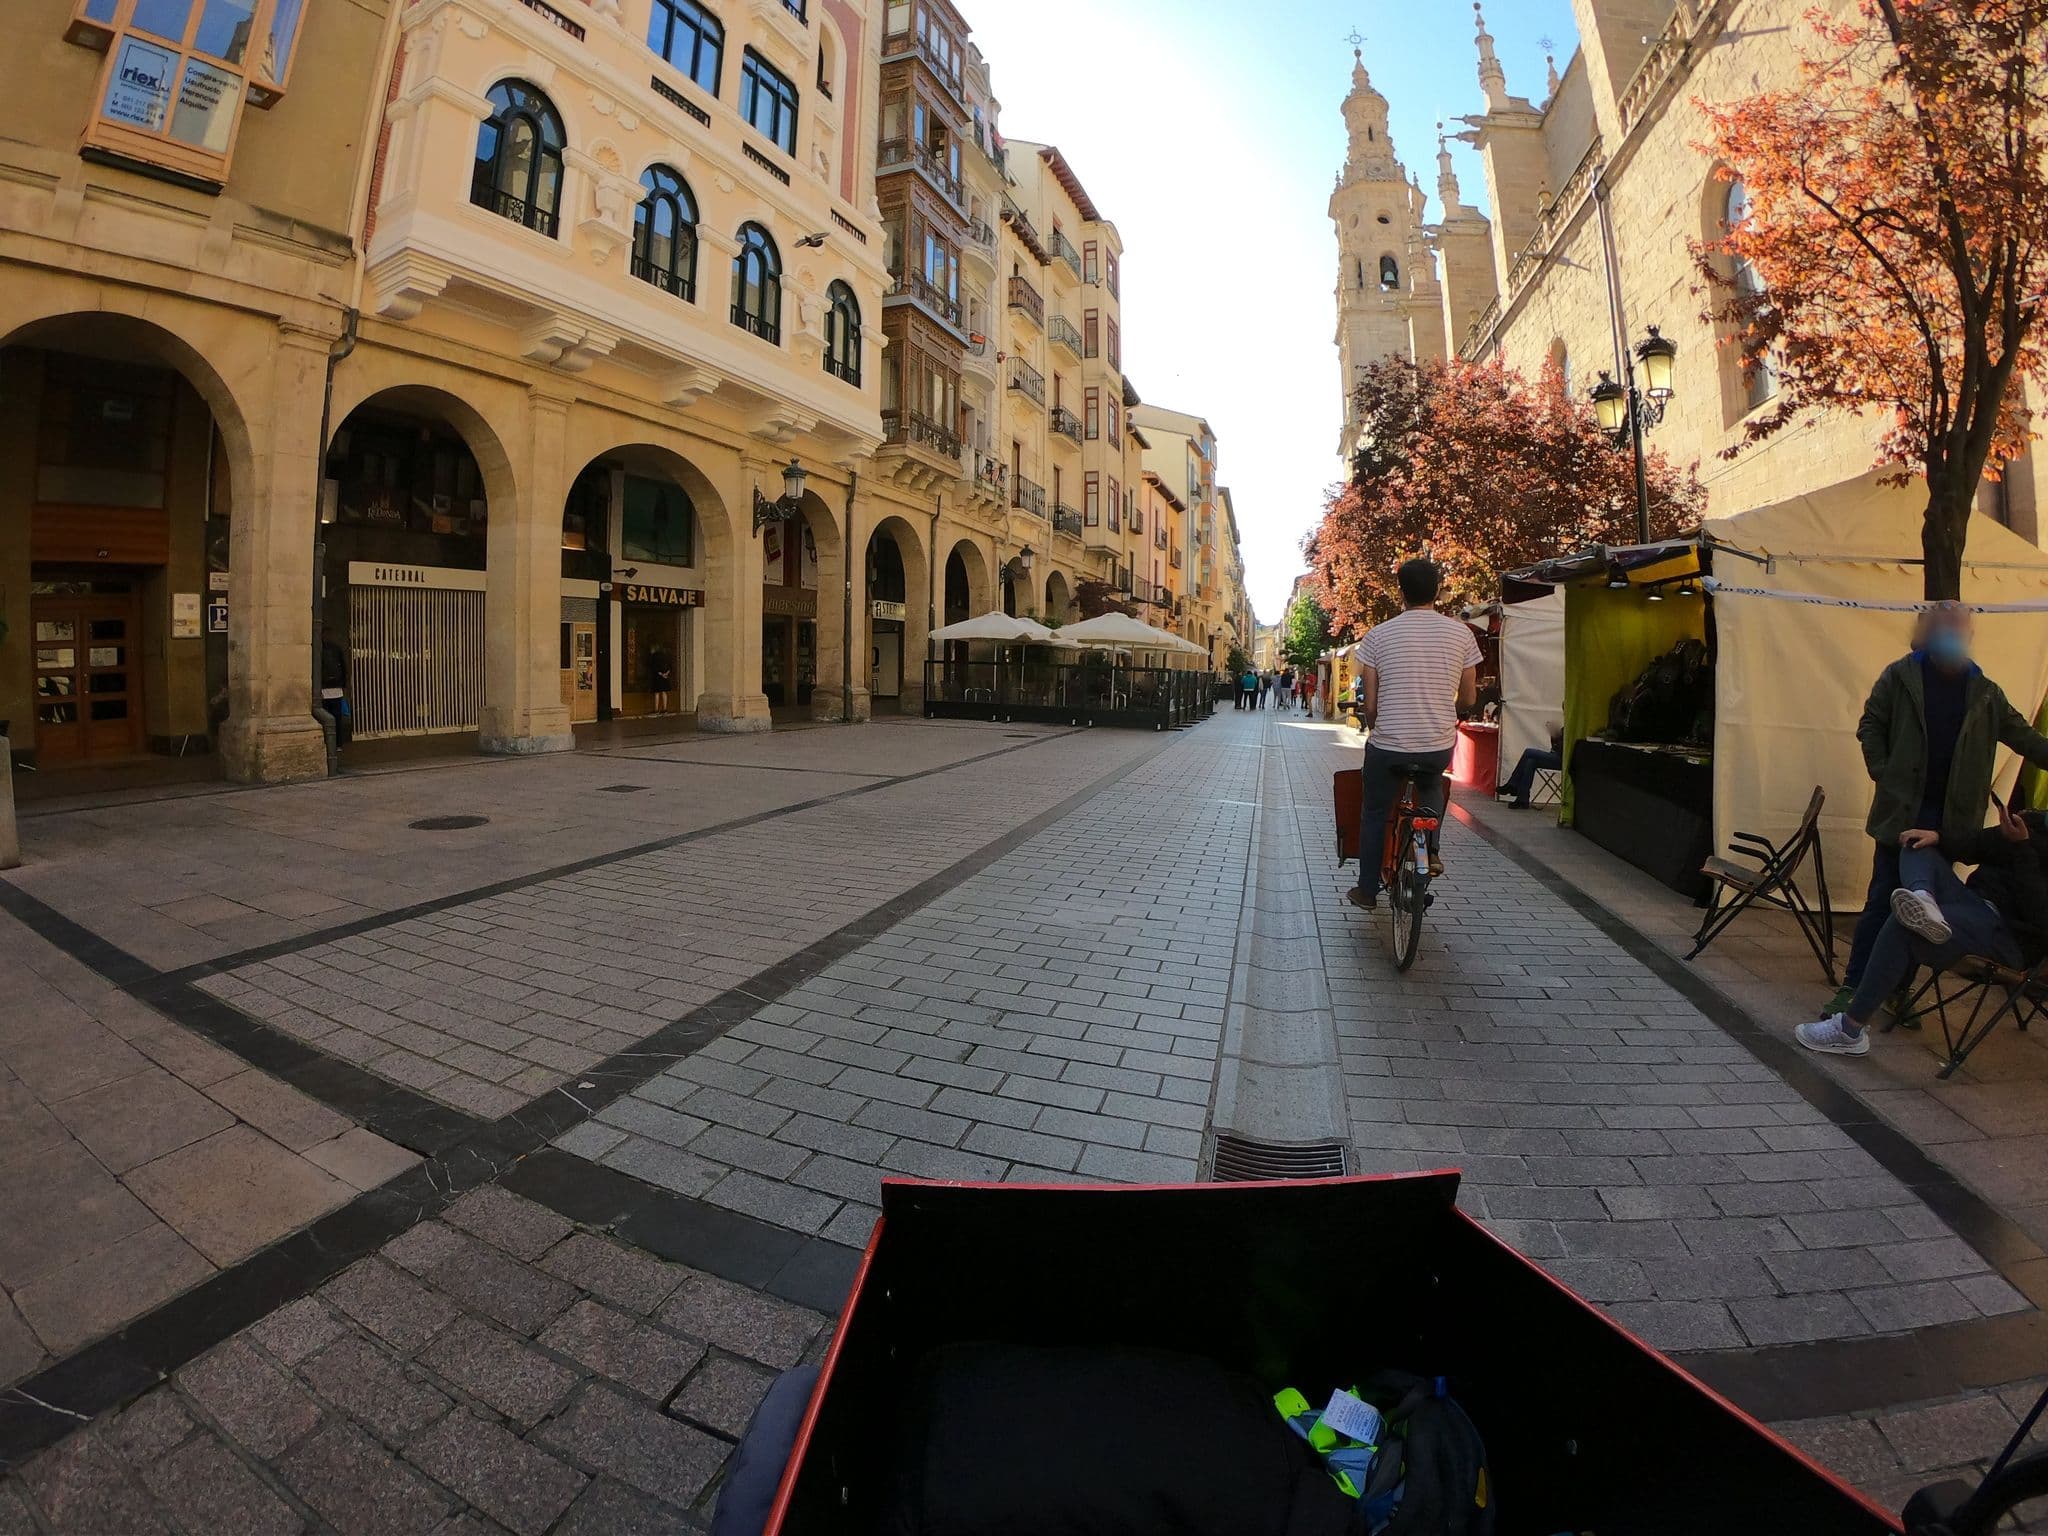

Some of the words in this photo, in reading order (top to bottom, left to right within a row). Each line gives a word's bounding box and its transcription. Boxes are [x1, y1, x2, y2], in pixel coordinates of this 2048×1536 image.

[122, 67, 159, 88] riex
[180, 97, 208, 111] Alquiler
[375, 567, 424, 583] CATEDRAL
[626, 585, 697, 605] SALVAJE
